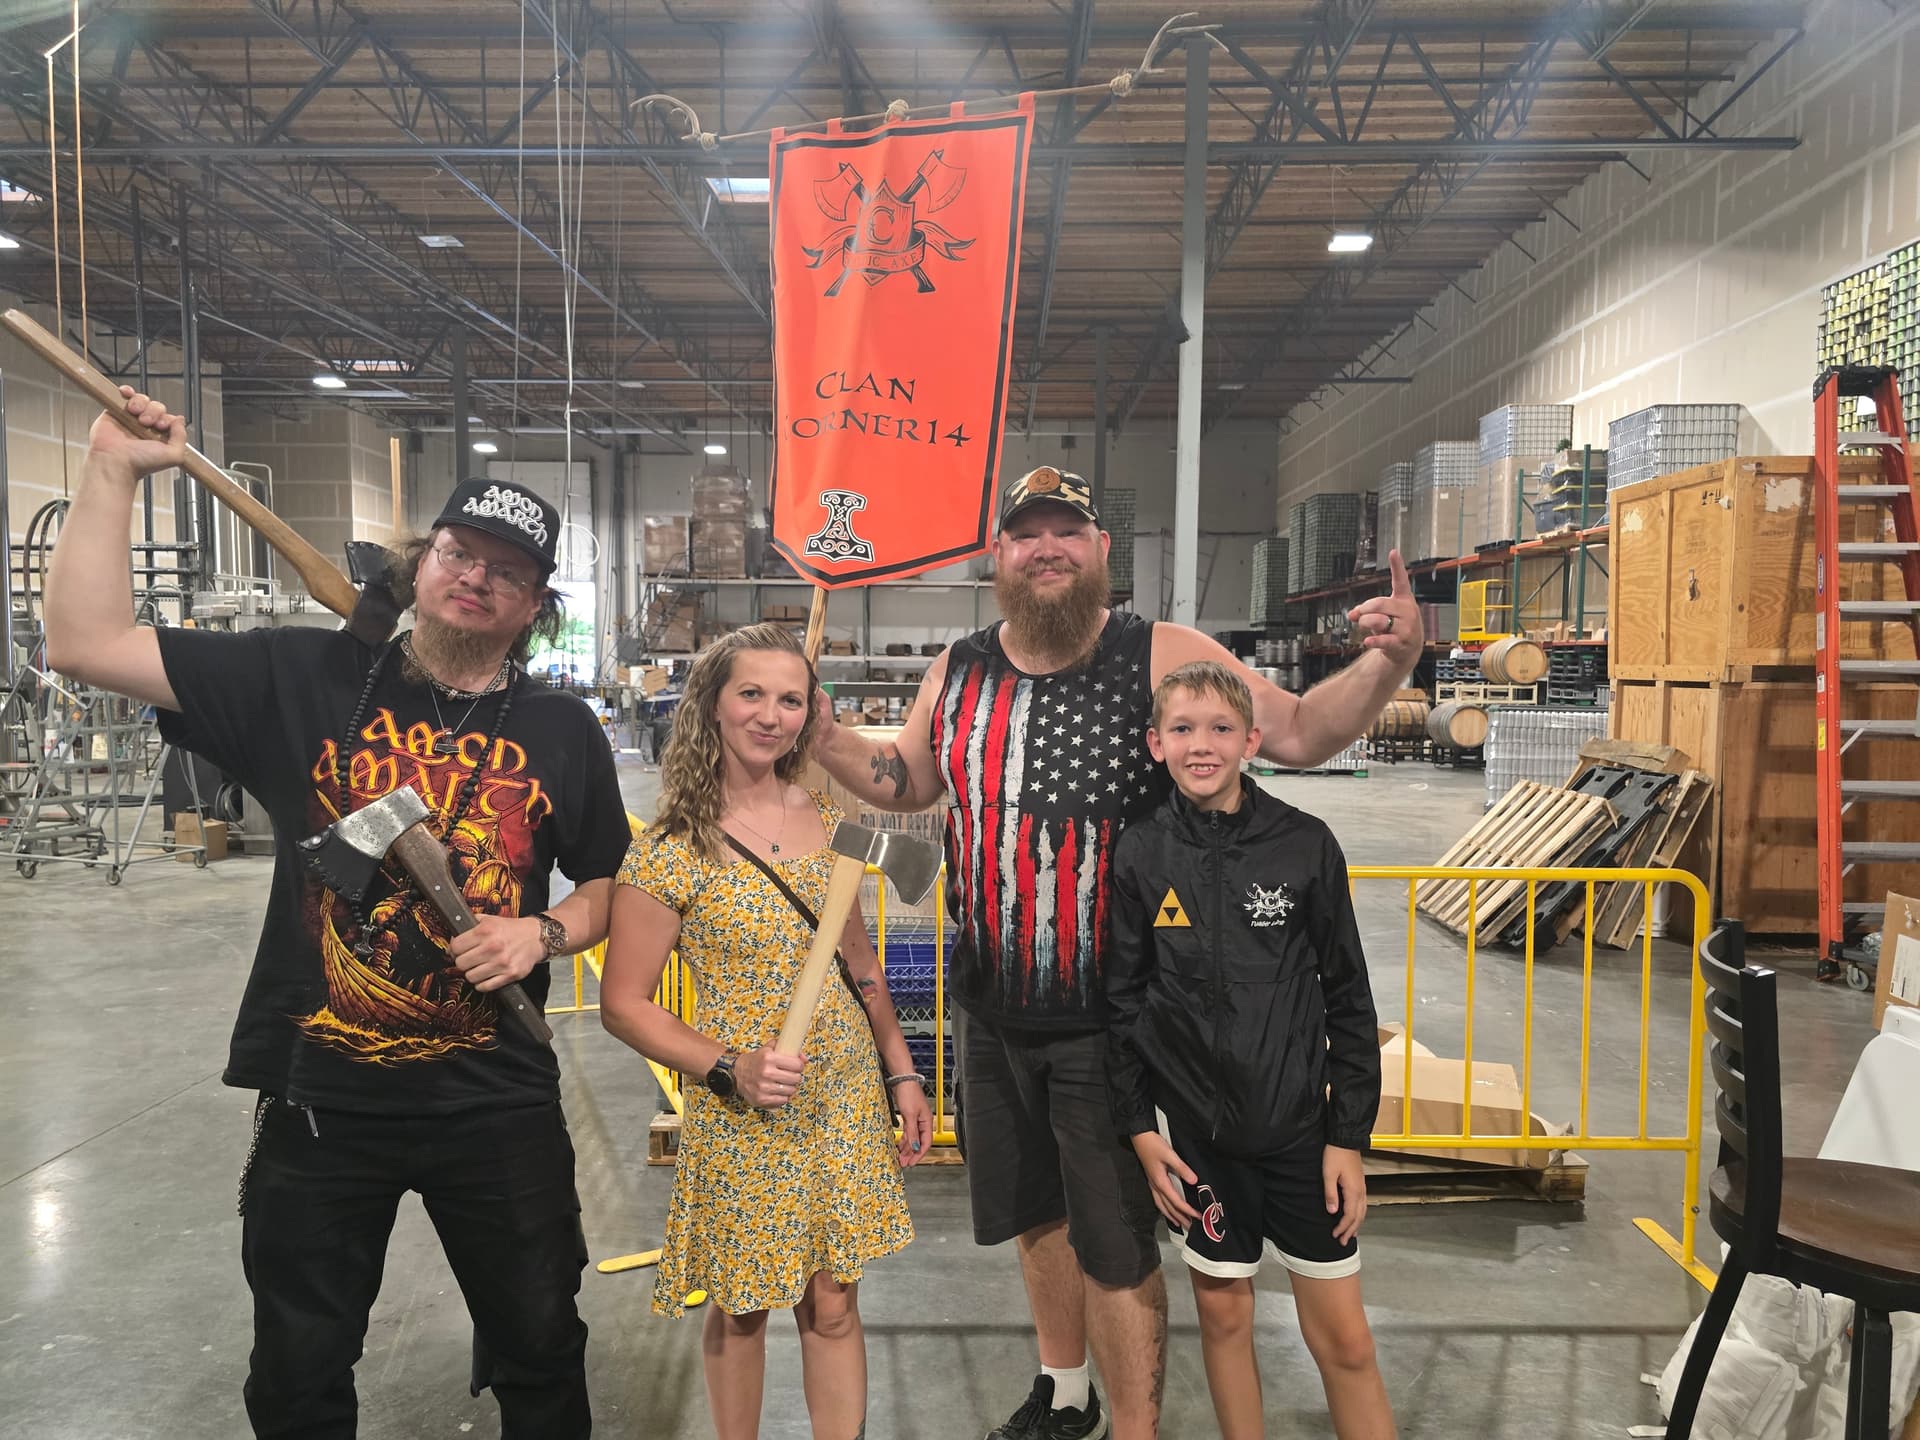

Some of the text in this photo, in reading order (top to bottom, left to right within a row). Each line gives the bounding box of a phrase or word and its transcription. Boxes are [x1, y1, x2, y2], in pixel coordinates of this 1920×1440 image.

[866, 205, 895, 245] C
[816, 371, 916, 404] CLAN
[784, 408, 972, 448] ORNER14
[361, 706, 528, 775] AMON
